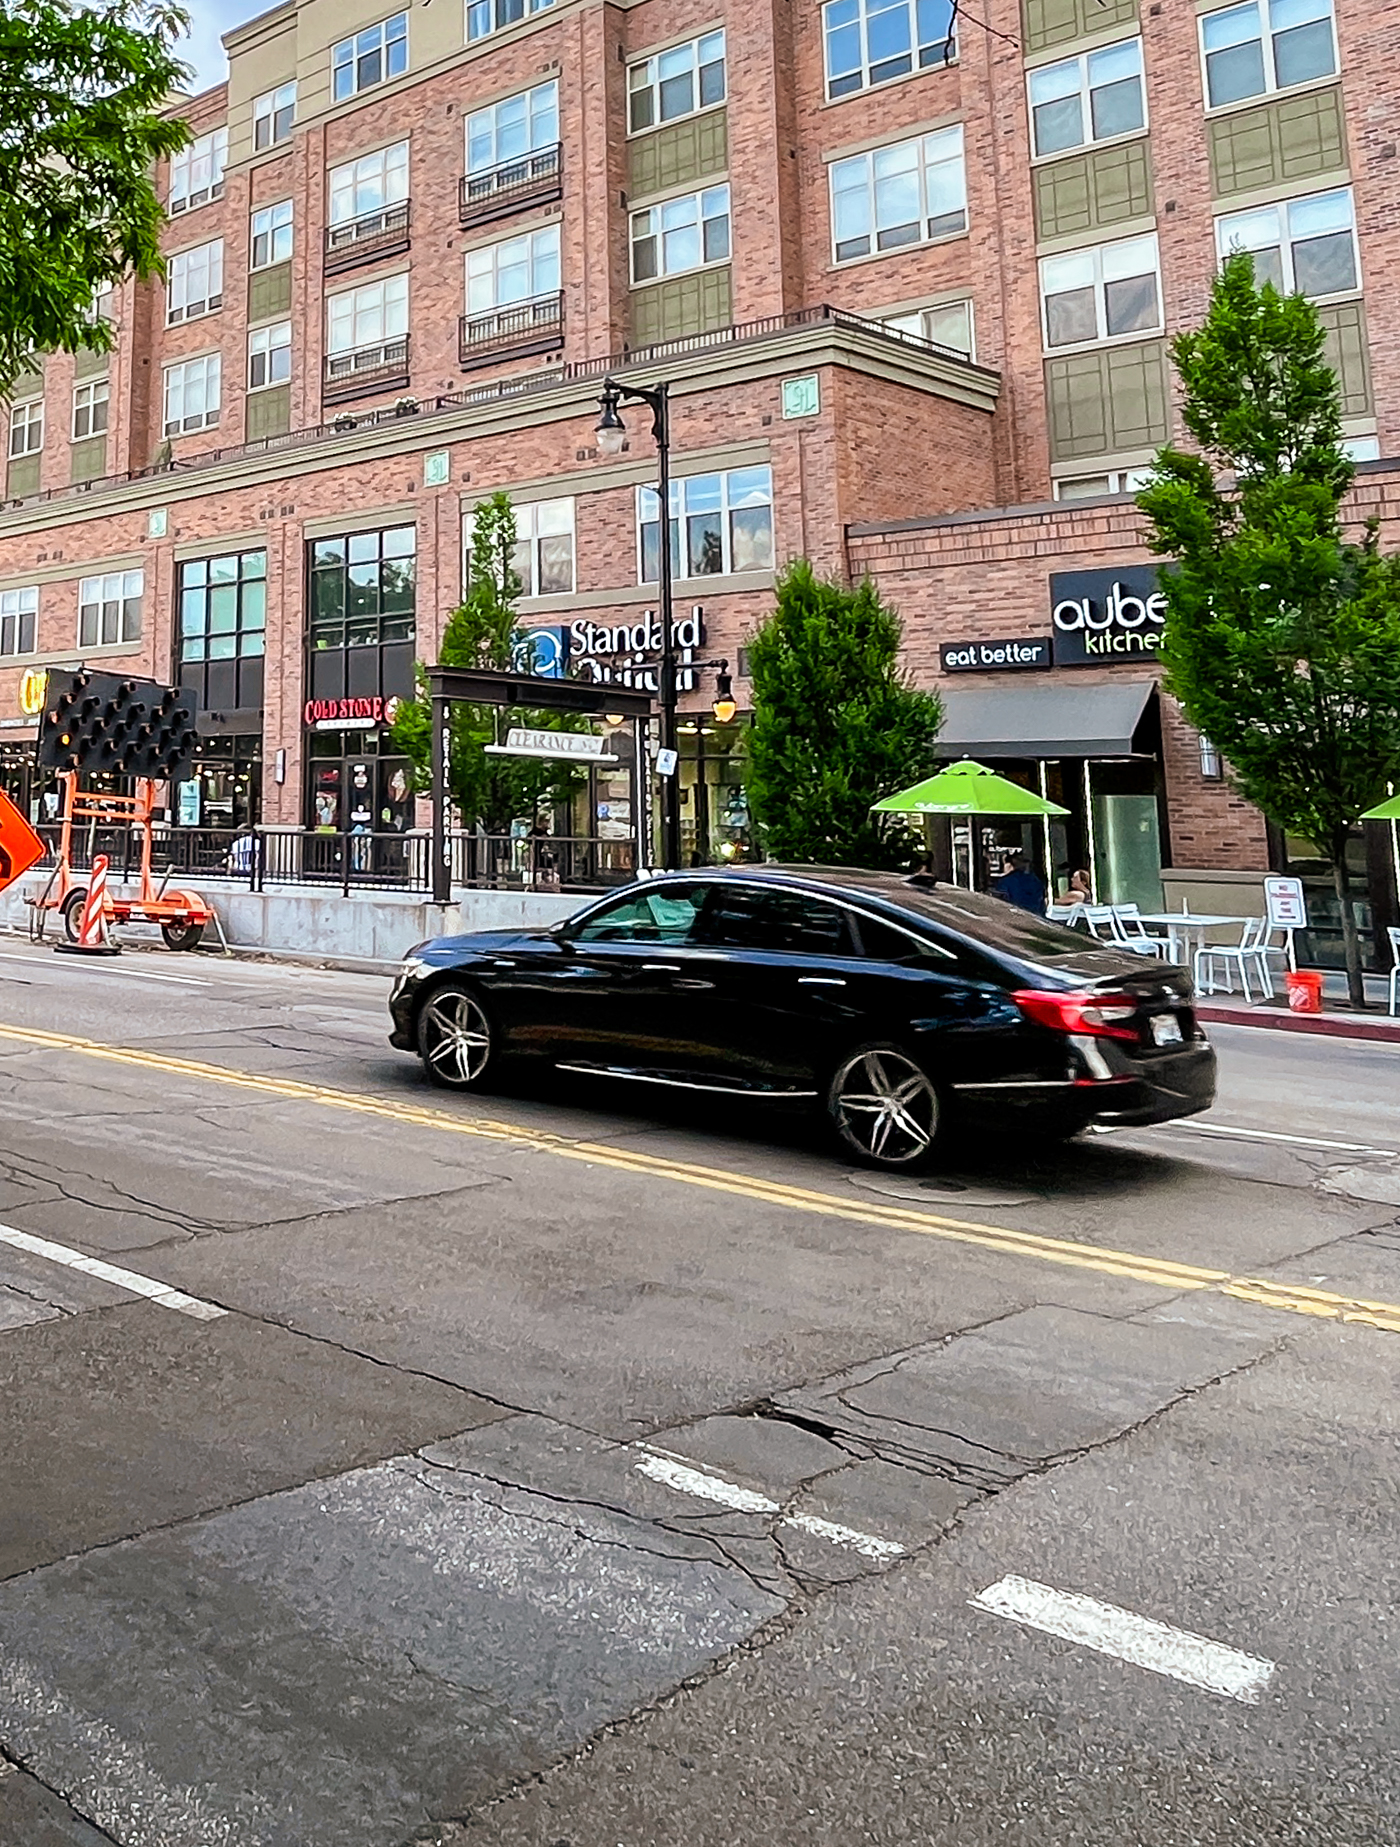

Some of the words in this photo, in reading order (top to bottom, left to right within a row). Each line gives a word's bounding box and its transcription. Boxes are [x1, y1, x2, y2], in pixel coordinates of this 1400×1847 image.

[569, 605, 700, 656] Standard
[1053, 581, 1170, 631] aube
[945, 646, 978, 667] eat
[980, 642, 1043, 665] better
[304, 699, 338, 725] COLD
[338, 696, 383, 721] STONE
[442, 727, 451, 789] RETAIL
